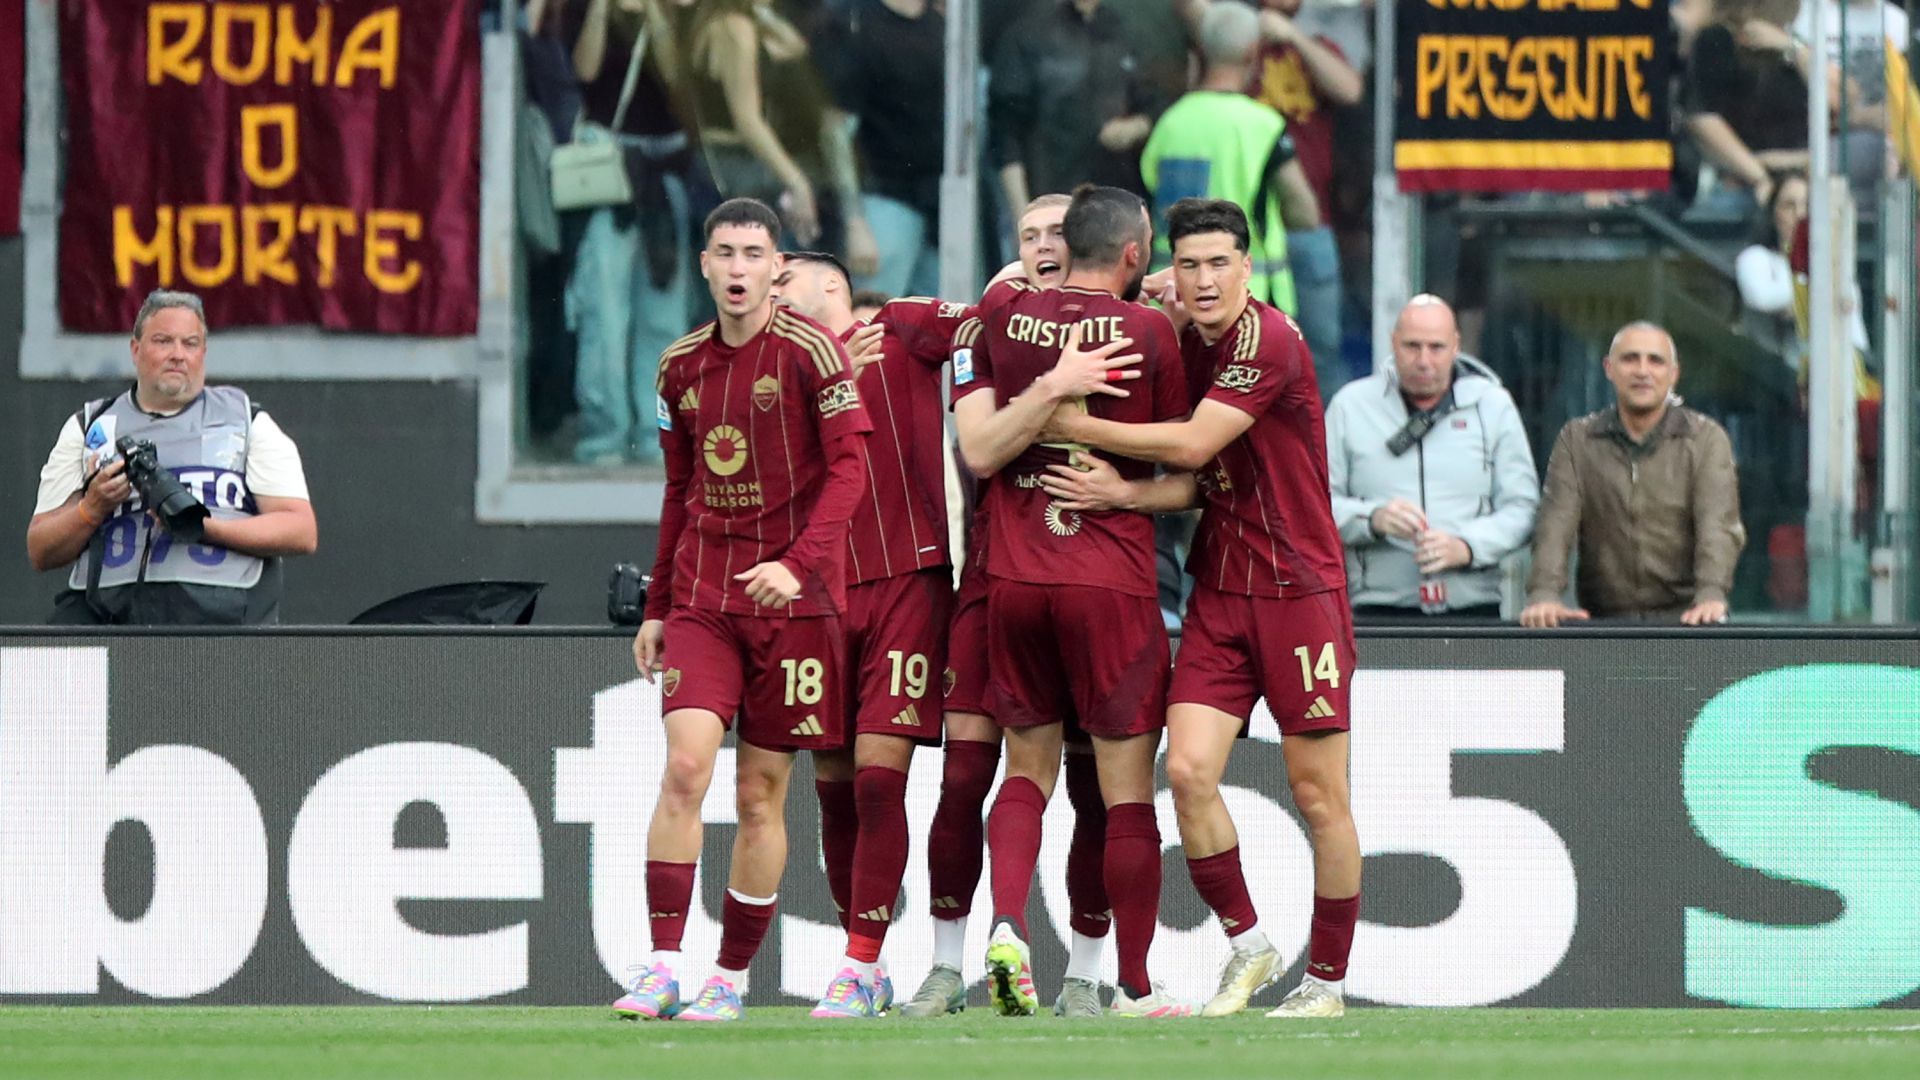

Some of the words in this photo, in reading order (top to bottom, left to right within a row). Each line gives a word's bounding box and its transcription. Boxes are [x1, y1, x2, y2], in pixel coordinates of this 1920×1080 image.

[147, 3, 399, 88] ROMA
[1416, 34, 1654, 120] PRESENTE
[241, 104, 297, 189] O
[112, 204, 422, 293] MORTE
[1006, 313, 1124, 349] CRISTNTE
[704, 482, 761, 495] RIYADH
[705, 495, 764, 507] SEASON
[780, 657, 824, 706] 18
[887, 650, 929, 699] 19
[1294, 642, 1340, 693] 14
